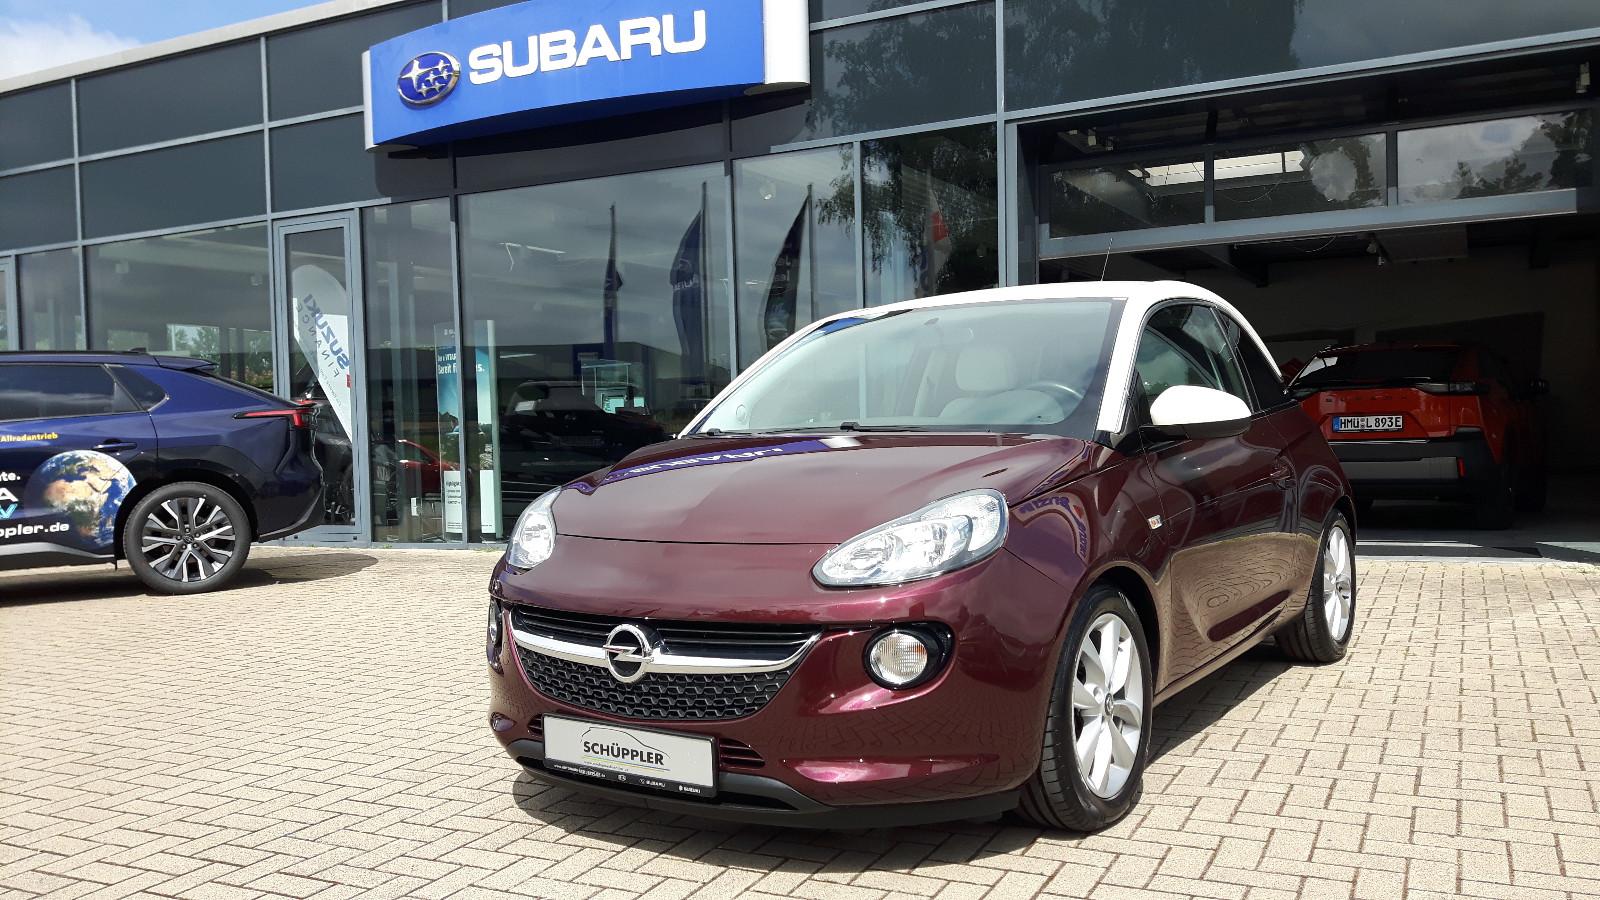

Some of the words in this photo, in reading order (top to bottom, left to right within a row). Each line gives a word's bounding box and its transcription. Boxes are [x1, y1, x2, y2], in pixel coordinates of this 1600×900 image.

[468, 10, 706, 86] SUBARU
[1340, 417, 1360, 429] HMÜ
[1366, 417, 1373, 428] L
[1374, 416, 1402, 428] 893E
[0, 472, 21, 481] te.
[583, 741, 665, 766] SCHÜPPLER
